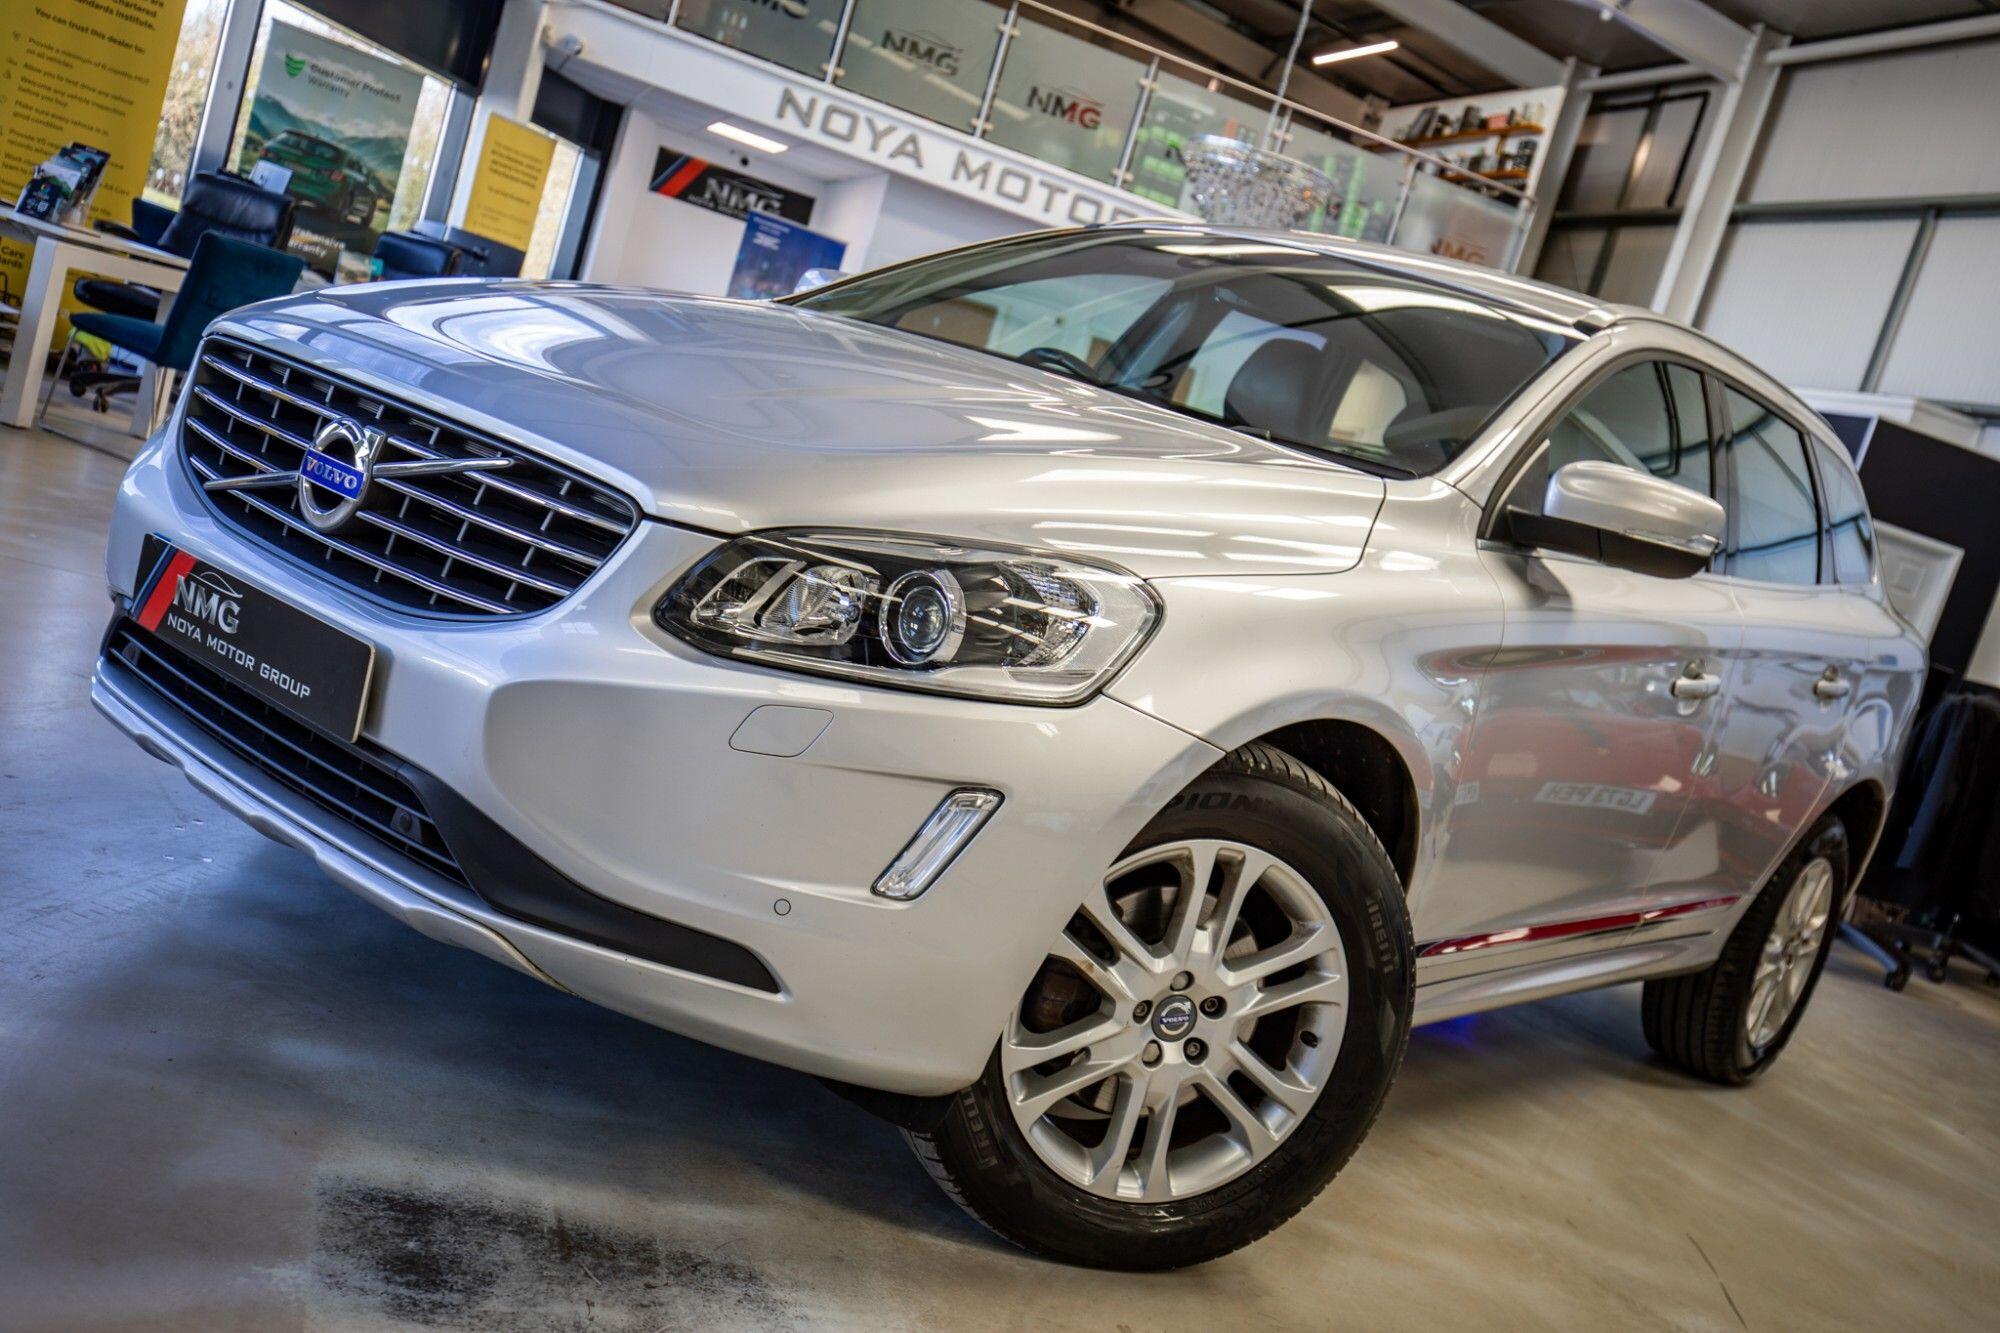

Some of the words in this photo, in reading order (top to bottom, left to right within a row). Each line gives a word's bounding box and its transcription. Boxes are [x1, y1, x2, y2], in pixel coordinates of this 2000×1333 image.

[35, 6, 52, 20] You
[68, 20, 89, 33] trust
[881, 29, 961, 79] NMG
[776, 87, 924, 169] NOYA
[1027, 86, 1103, 131] NMG
[703, 177, 782, 217] NMG
[287, 240, 328, 258] arranty
[305, 456, 358, 491] VOLVO
[173, 574, 241, 635] NMG
[167, 612, 203, 644] NOYA
[206, 636, 255, 673] MOTOR
[259, 661, 312, 700] GROUP
[1162, 1015, 1190, 1023] VOLVO
